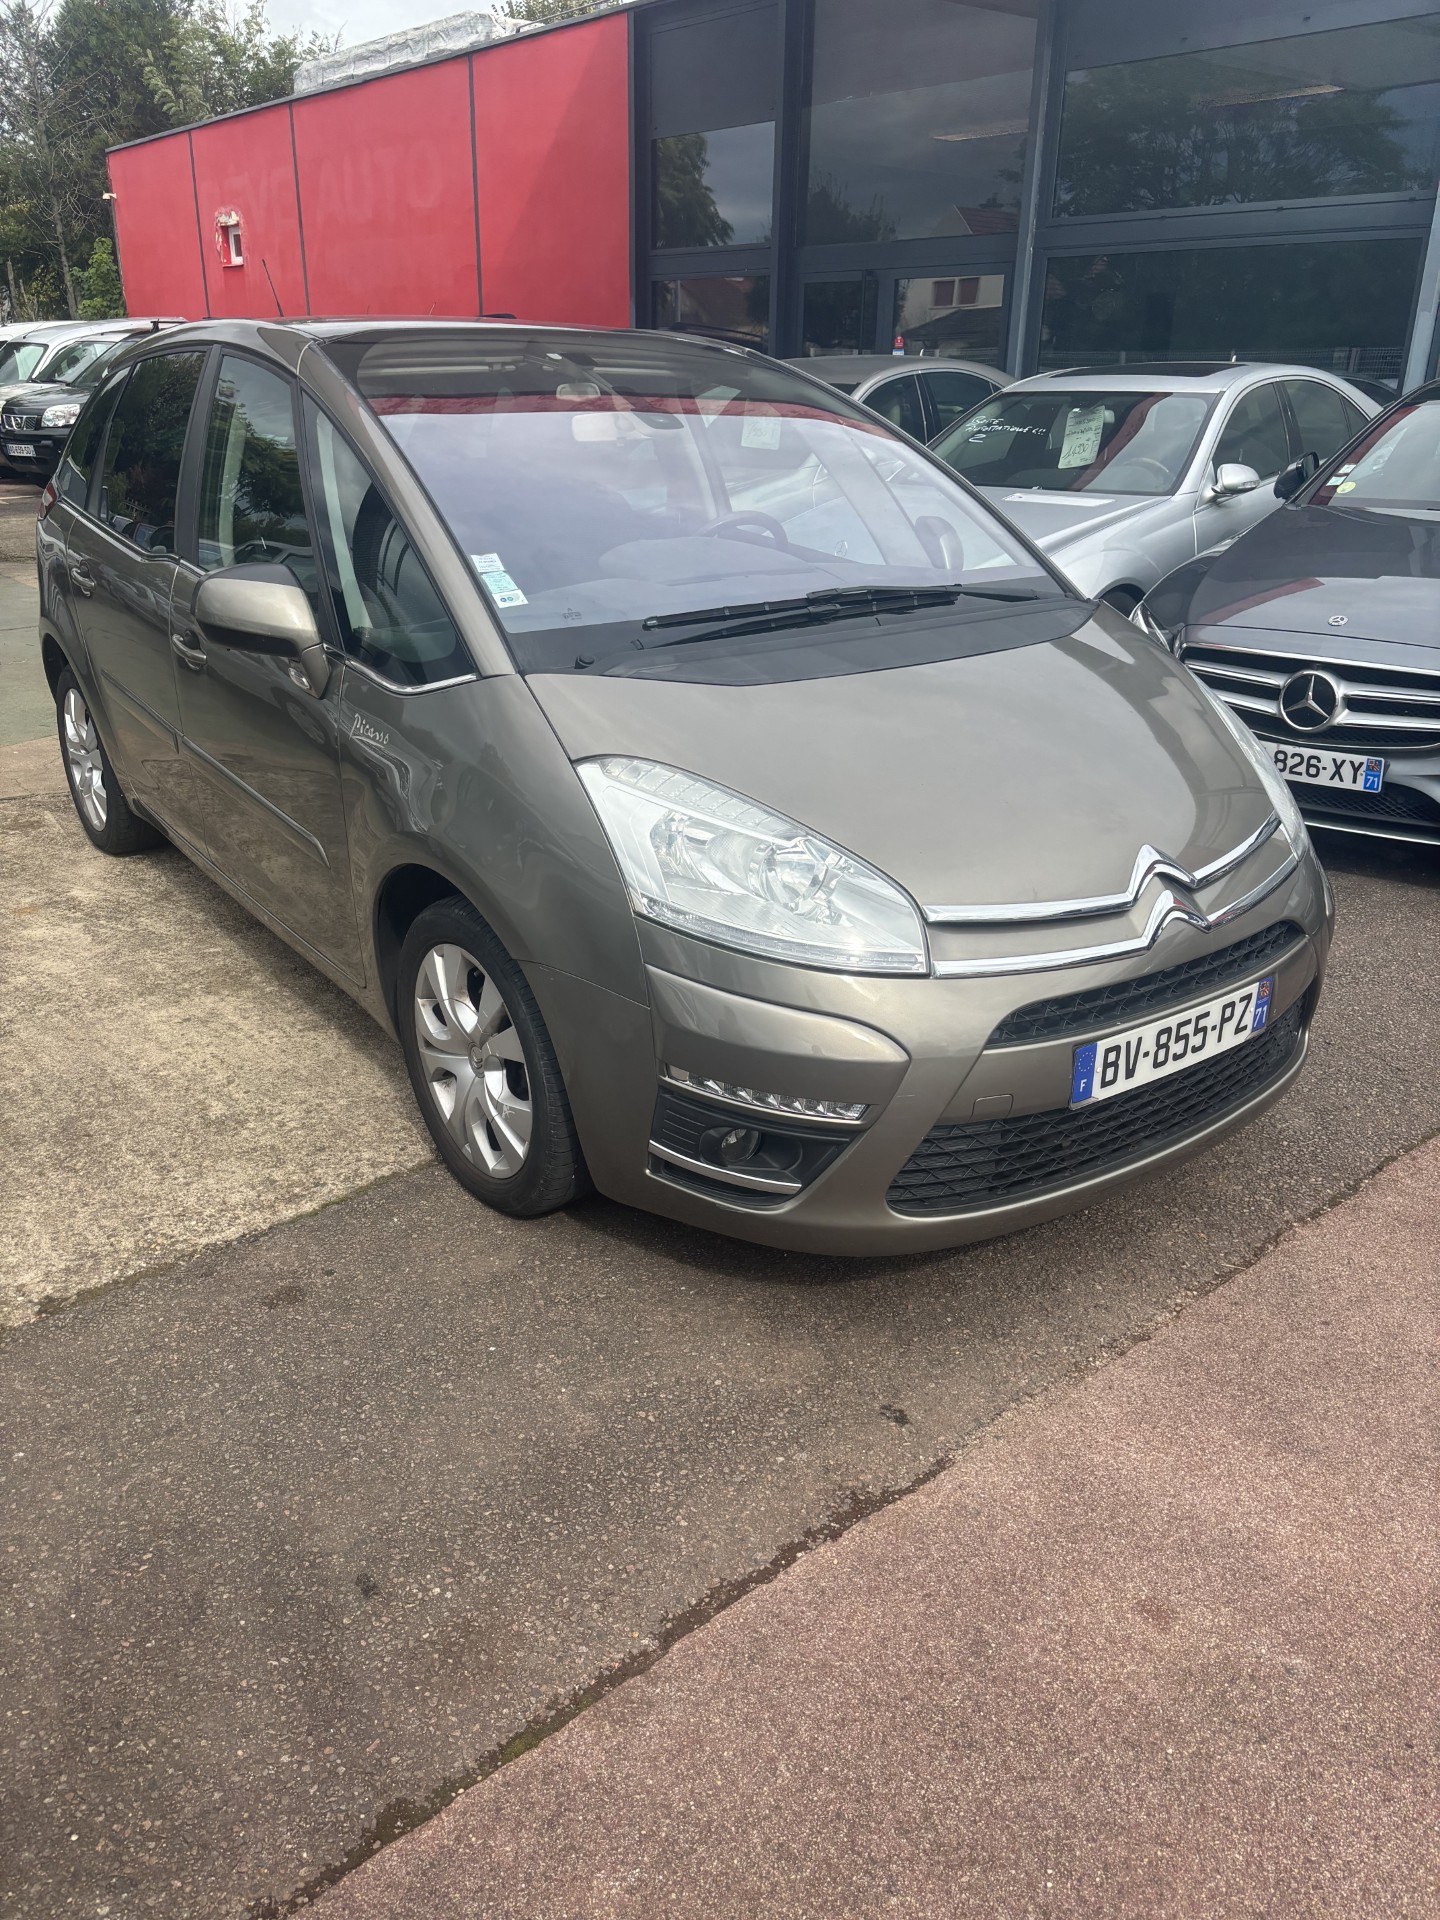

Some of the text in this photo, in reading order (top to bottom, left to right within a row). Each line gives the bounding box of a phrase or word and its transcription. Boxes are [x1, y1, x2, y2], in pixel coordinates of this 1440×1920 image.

[349, 713, 389, 745] Picasso
[1366, 776, 1378, 789] 71
[1079, 993, 1268, 1093] F BV-855-PZ 71
